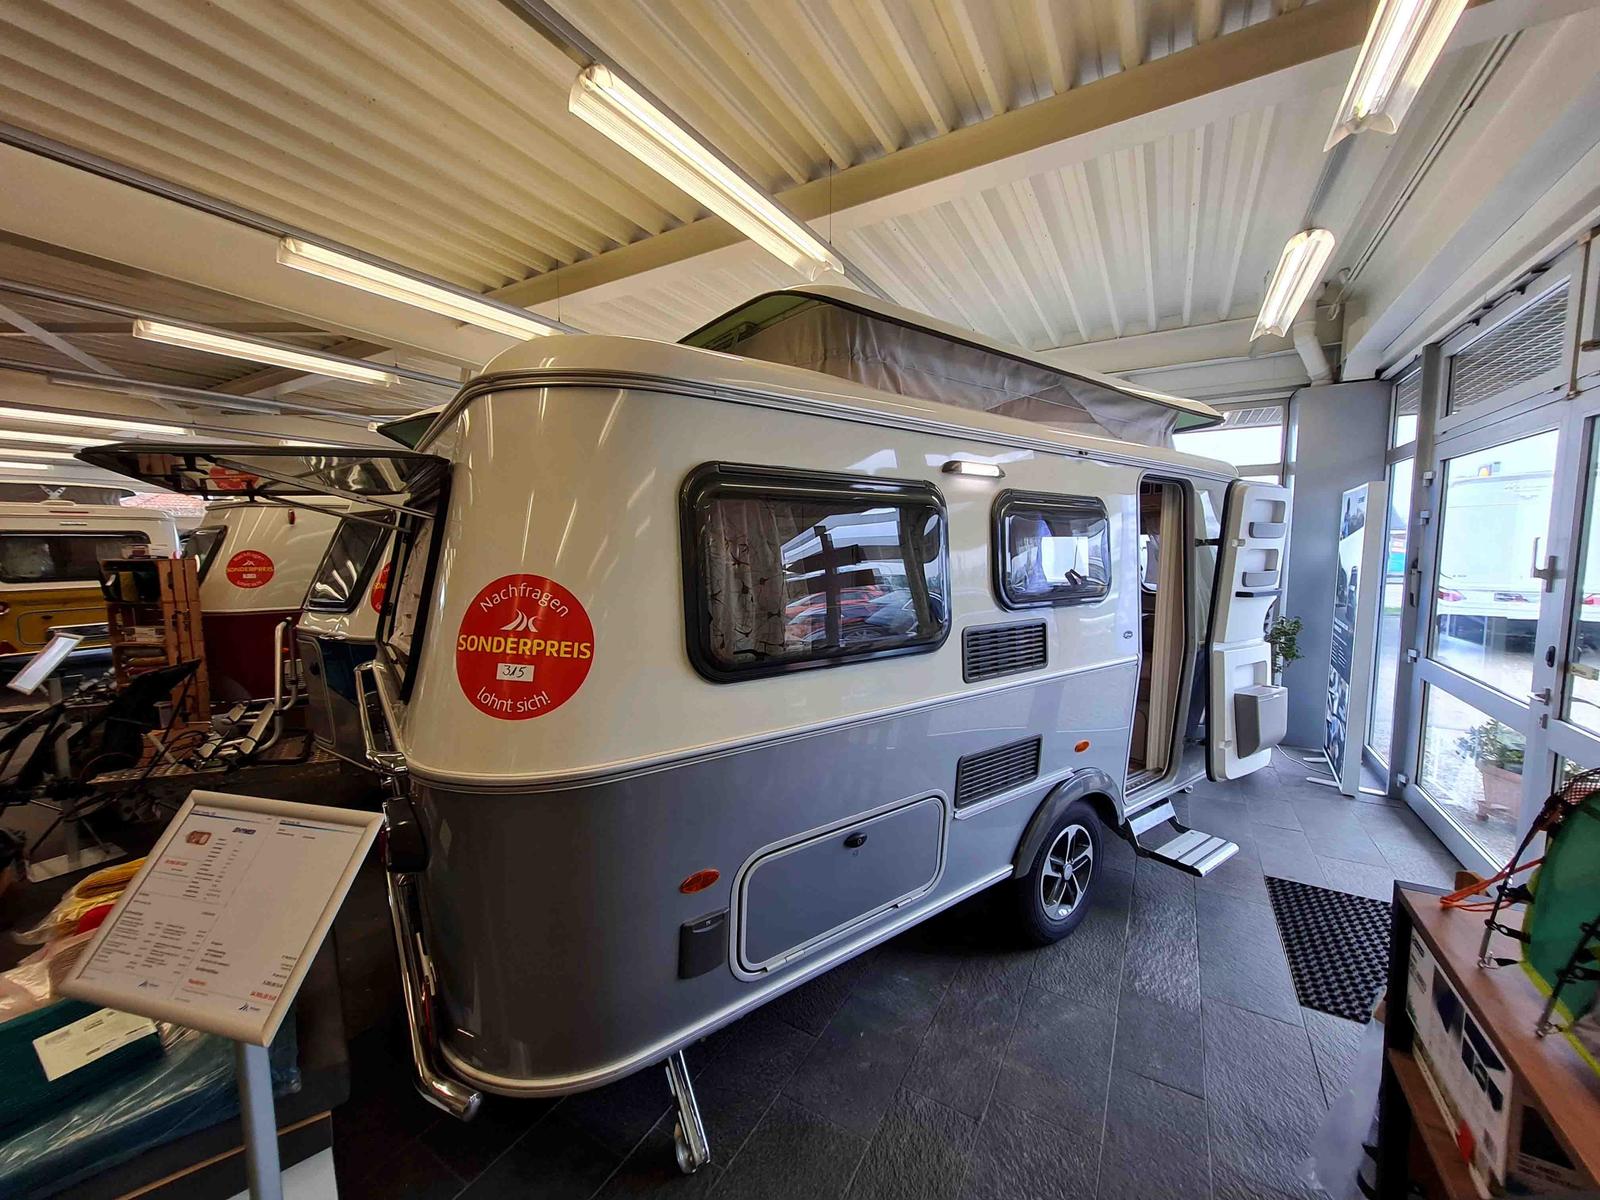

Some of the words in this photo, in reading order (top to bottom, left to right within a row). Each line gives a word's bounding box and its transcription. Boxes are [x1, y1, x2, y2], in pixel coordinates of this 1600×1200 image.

[479, 582, 569, 618] Nachfragen
[457, 634, 592, 659] SONDERPREIS
[502, 664, 527, 678] 315
[476, 686, 514, 713] lohnt
[516, 690, 552, 713] sich!
